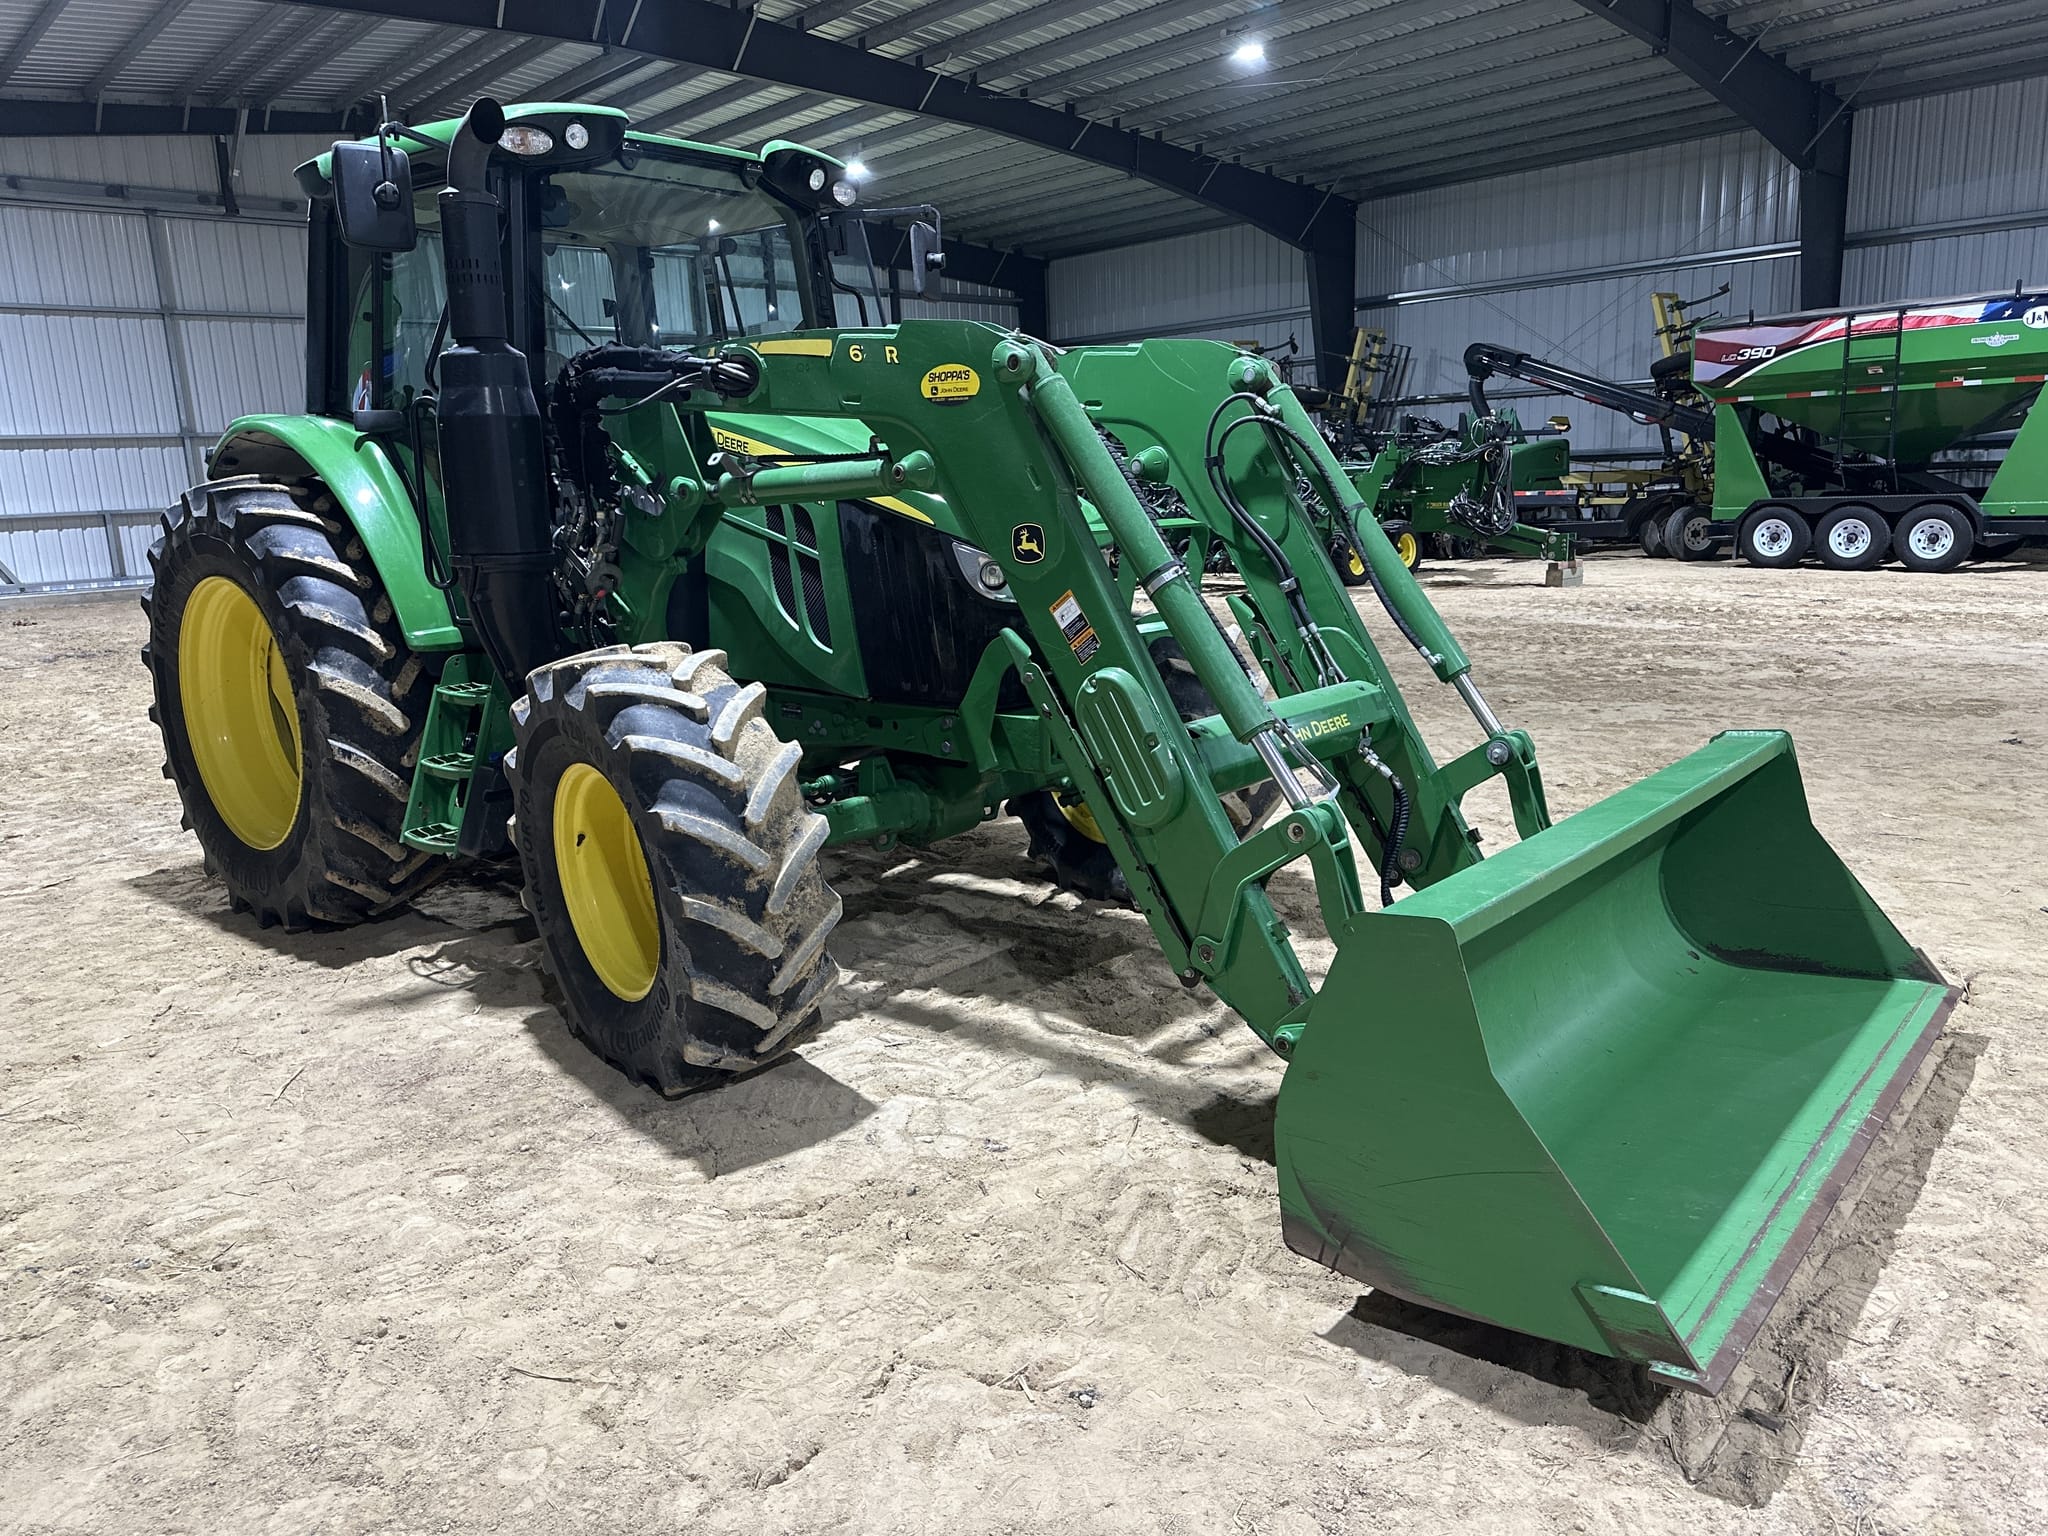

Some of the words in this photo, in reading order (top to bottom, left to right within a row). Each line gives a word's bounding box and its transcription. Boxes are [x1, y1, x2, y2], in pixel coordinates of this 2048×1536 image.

[884, 345, 900, 363] R
[928, 369, 970, 383] SHOPPA'S
[940, 386, 953, 394] JOHN
[717, 431, 750, 454] DEERE
[1310, 713, 1351, 737] DEERE
[519, 787, 532, 816] 70
[521, 821, 549, 926] TRACTOR
